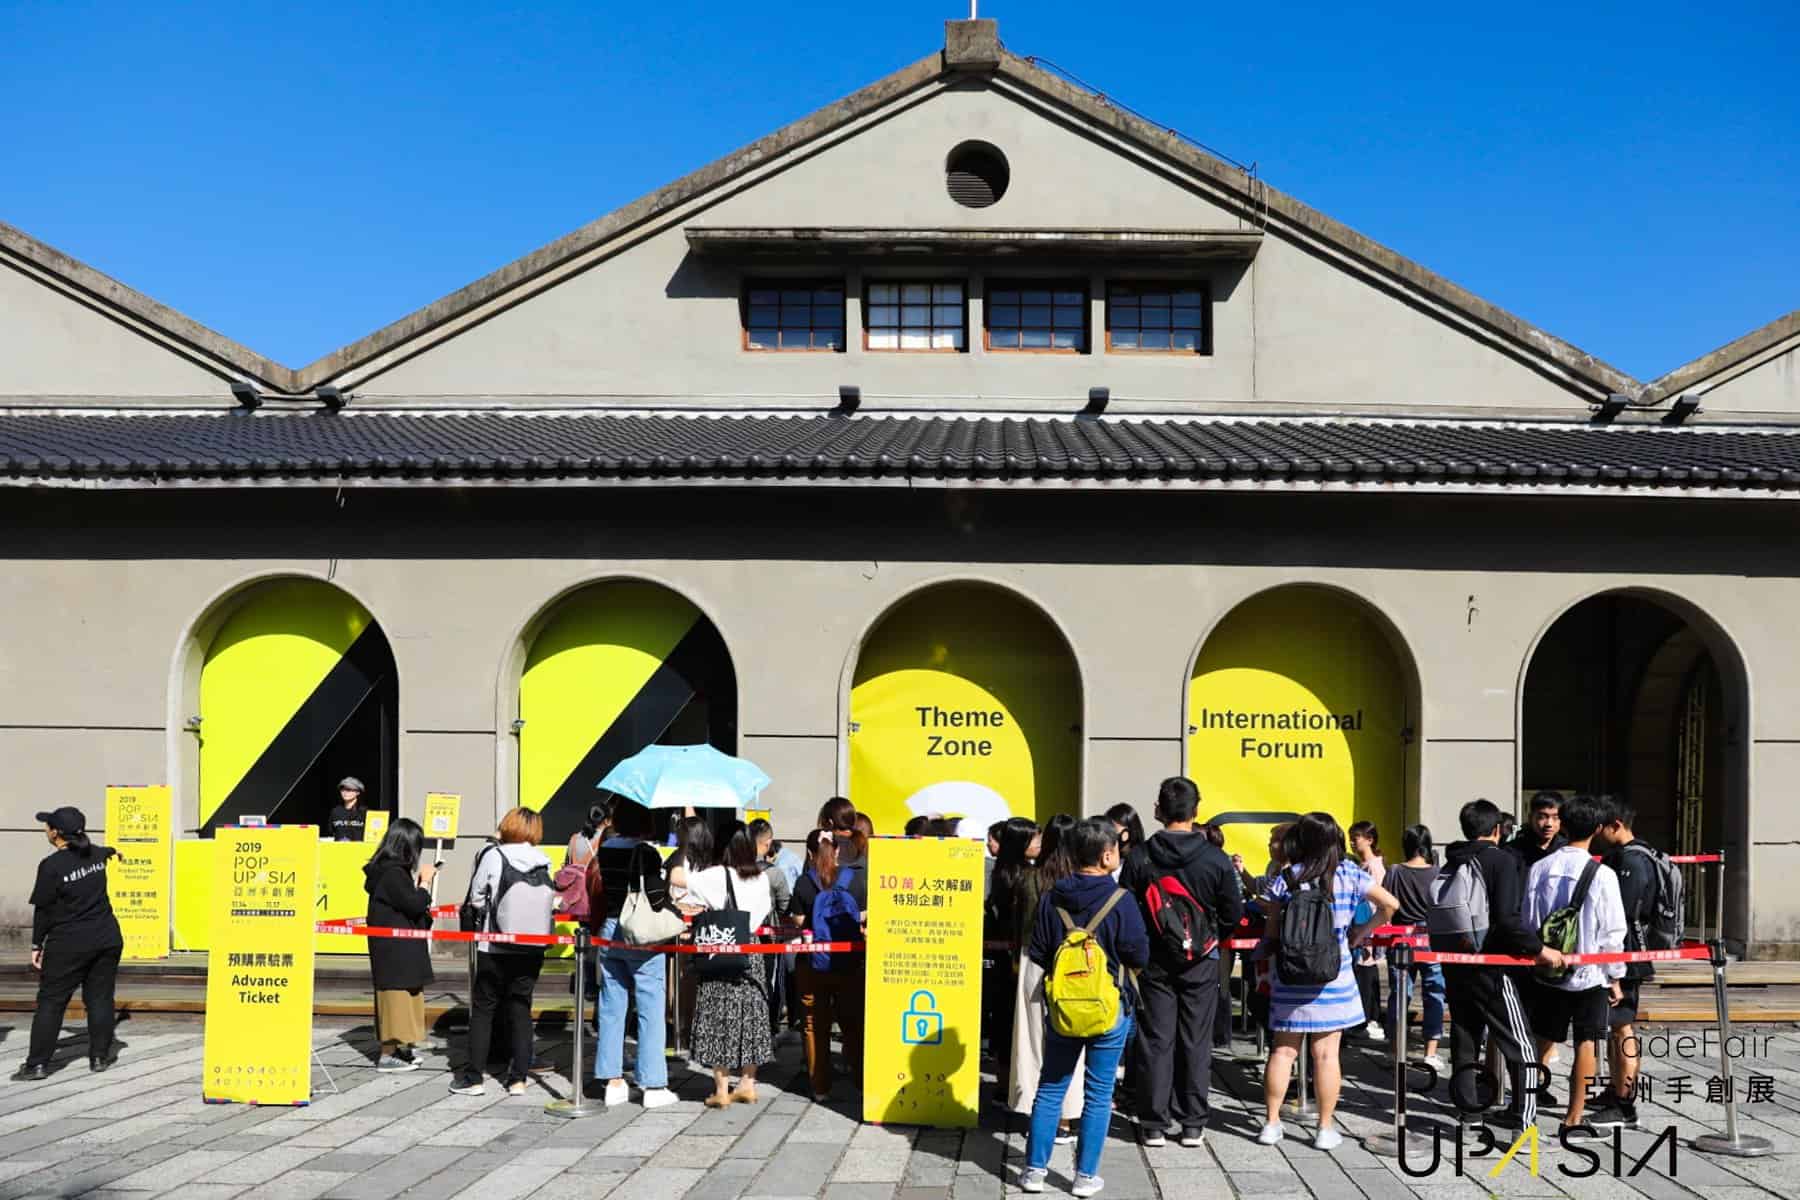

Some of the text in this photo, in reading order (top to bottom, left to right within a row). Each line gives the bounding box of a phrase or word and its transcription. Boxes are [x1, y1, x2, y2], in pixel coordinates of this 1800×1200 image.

[915, 706, 1004, 727] Theme
[1202, 708, 1363, 731] International
[927, 736, 992, 756] Zone
[1241, 738, 1323, 758] Forum
[119, 814, 158, 823] UPSIA
[235, 842, 262, 853] 2019
[234, 856, 269, 869] POP
[233, 871, 296, 884] UPSIA
[228, 953, 294, 967] 預購票驗票
[232, 974, 288, 987] Advance
[239, 991, 280, 1003] Ticket
